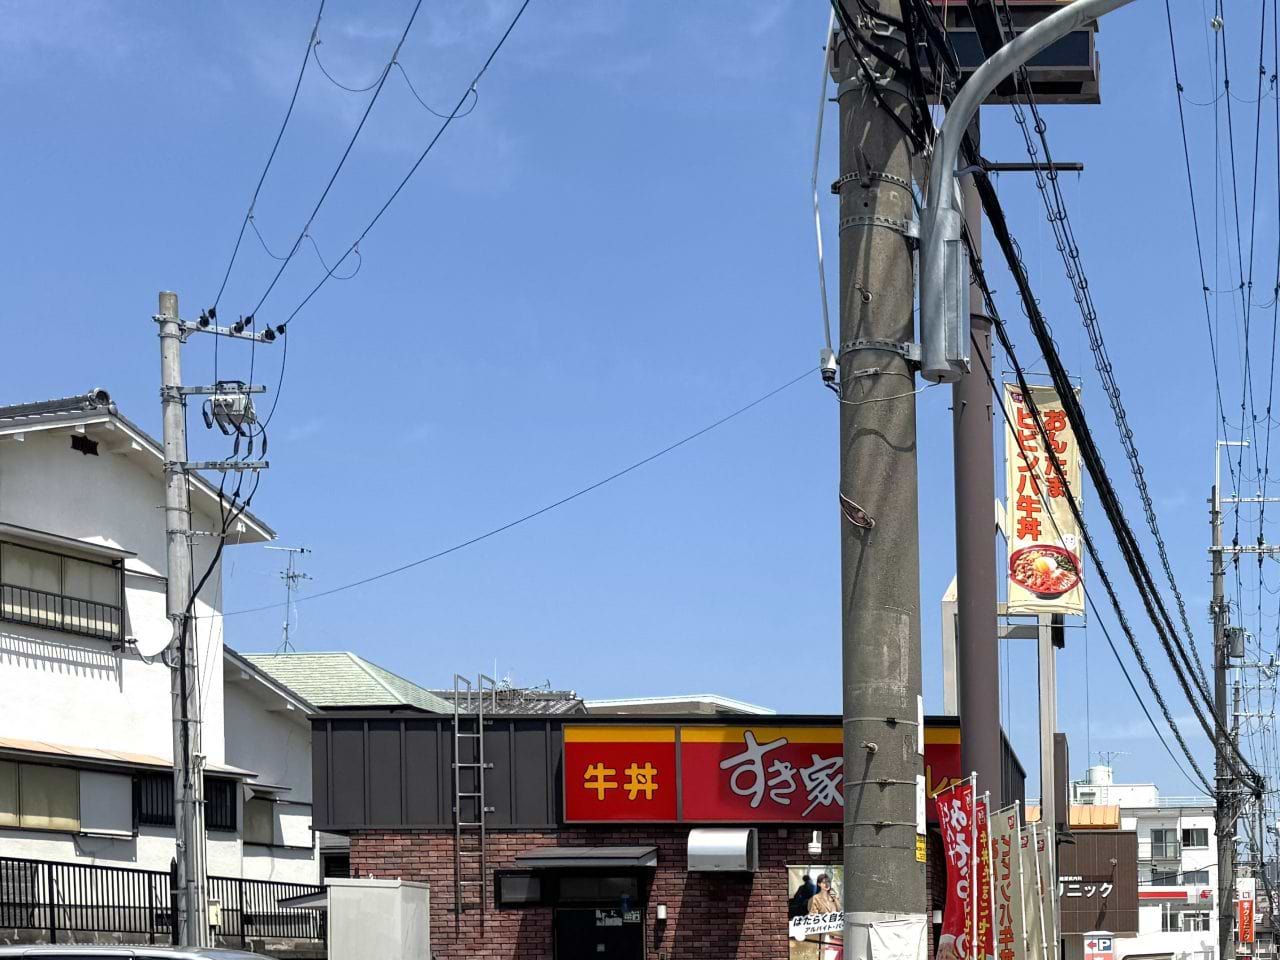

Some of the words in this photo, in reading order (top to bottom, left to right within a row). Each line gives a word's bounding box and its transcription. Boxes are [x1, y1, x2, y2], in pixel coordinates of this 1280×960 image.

[1043, 409, 1067, 498] おんたま
[583, 761, 659, 802] 牛丼
[720, 730, 844, 817] すき家
[1099, 939, 1111, 951] P
